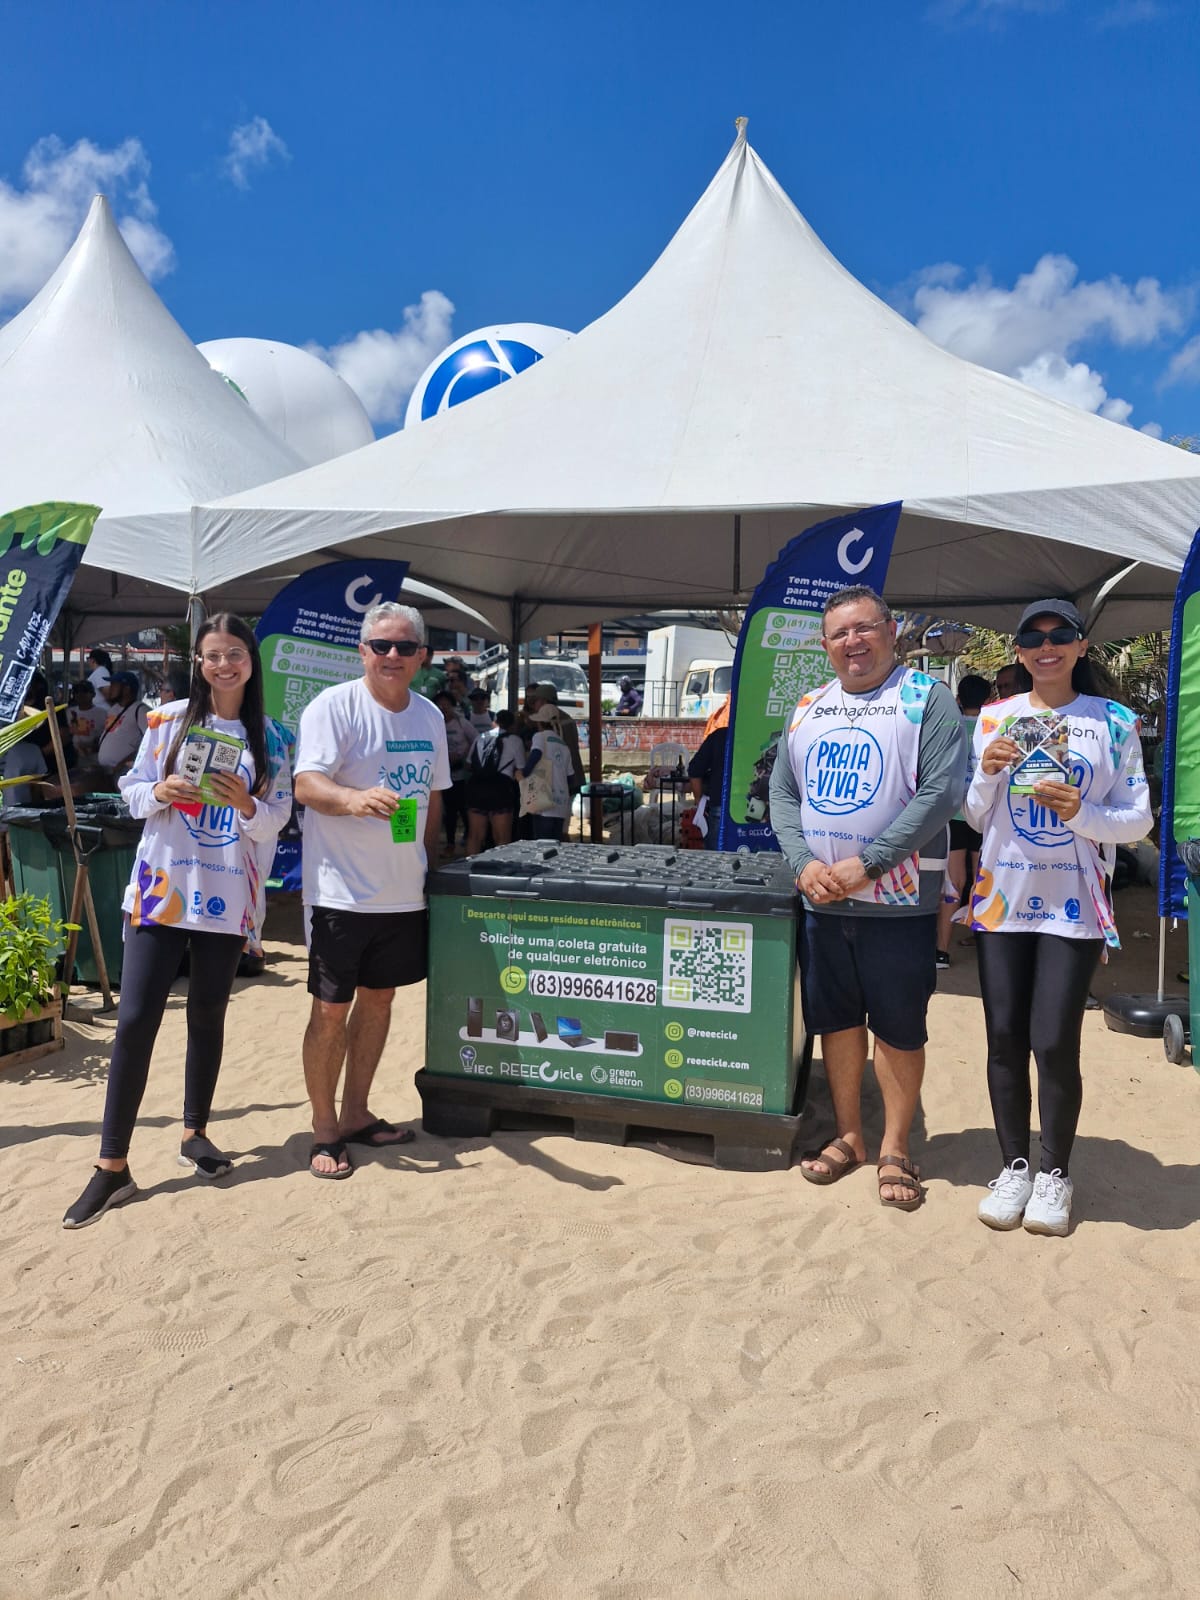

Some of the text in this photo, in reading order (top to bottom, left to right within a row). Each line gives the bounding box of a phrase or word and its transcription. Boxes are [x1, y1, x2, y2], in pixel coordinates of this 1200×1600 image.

[789, 576, 809, 585] Tem
[786, 587, 833, 598] para desc
[0, 569, 27, 642] ante
[783, 597, 818, 608] Chame
[296, 618, 360, 635] para descartar
[298, 608, 362, 627] Tem eletrônico
[808, 621, 821, 630] 99
[16, 611, 42, 659] CADA VEZ
[30, 618, 51, 660] MELHOR
[292, 626, 326, 638] Chame
[334, 635, 360, 645] gente
[817, 741, 870, 770] PRAIA
[817, 770, 859, 800] VIVA
[198, 804, 234, 832] IVA
[1029, 797, 1065, 828] VIV
[829, 830, 853, 840] nosso
[857, 834, 874, 844] lito
[202, 862, 226, 872] nosso
[229, 866, 244, 876] lito
[996, 859, 1024, 870] Juntos
[1028, 863, 1046, 872] pelo
[1052, 863, 1078, 871] nosso
[467, 908, 642, 929] Descarte aqui seus resíduos eletrônicos
[1016, 911, 1056, 920] tvglobo
[480, 932, 647, 954] Solicite uma coleta gratuita
[508, 949, 647, 969] de qualquer eletrônico
[530, 973, 656, 1004] (83)996641628
[688, 1028, 738, 1040] @reeecicle
[474, 1065, 494, 1075] IEC
[686, 1057, 750, 1070] reeecicle.com
[609, 1068, 636, 1078] green
[609, 1077, 643, 1088] eletron
[685, 1084, 763, 1106] (83)996641628
